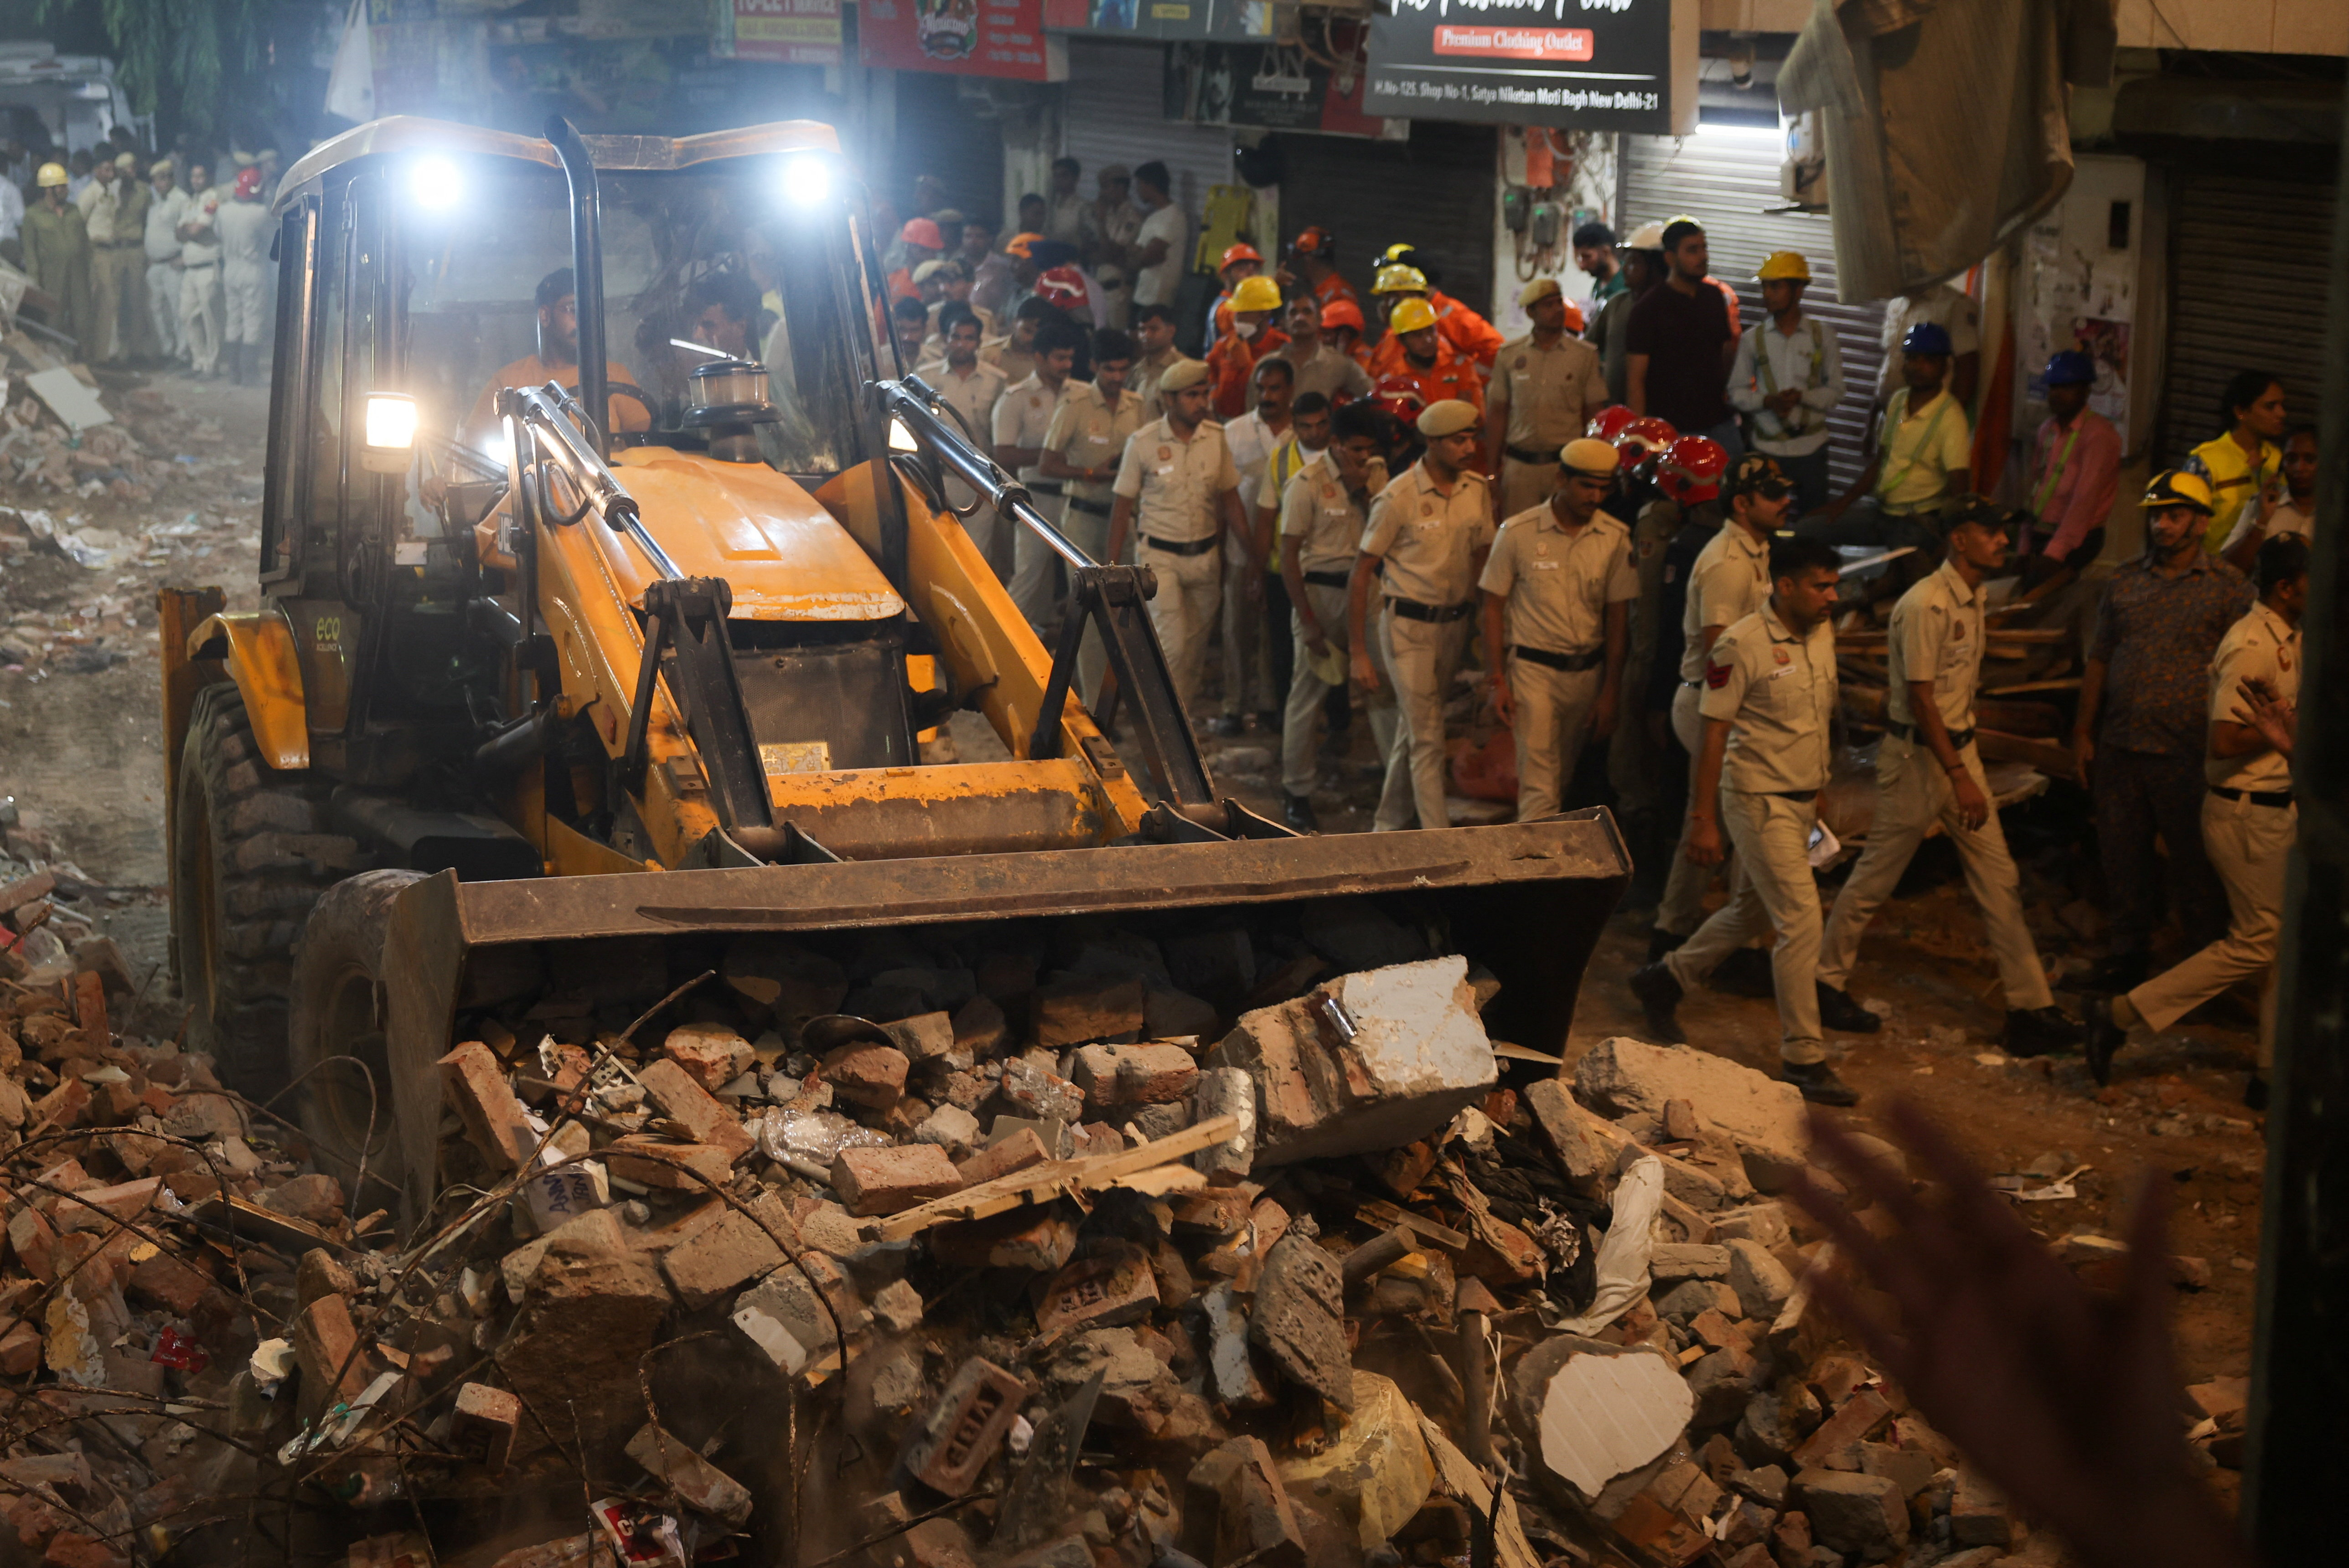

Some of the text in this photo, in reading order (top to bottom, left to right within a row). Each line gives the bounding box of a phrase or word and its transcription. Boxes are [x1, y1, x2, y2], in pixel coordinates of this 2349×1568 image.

[1442, 29, 1583, 56] Premium Clothing Outlet
[1419, 81, 1443, 102] Shop
[1498, 86, 1536, 104] Niketan
[1537, 87, 1561, 105] Moti
[1562, 89, 1588, 111] Bagh
[1588, 90, 1613, 108] New
[1613, 91, 1658, 110] Delhi-21
[316, 617, 340, 641] eco
